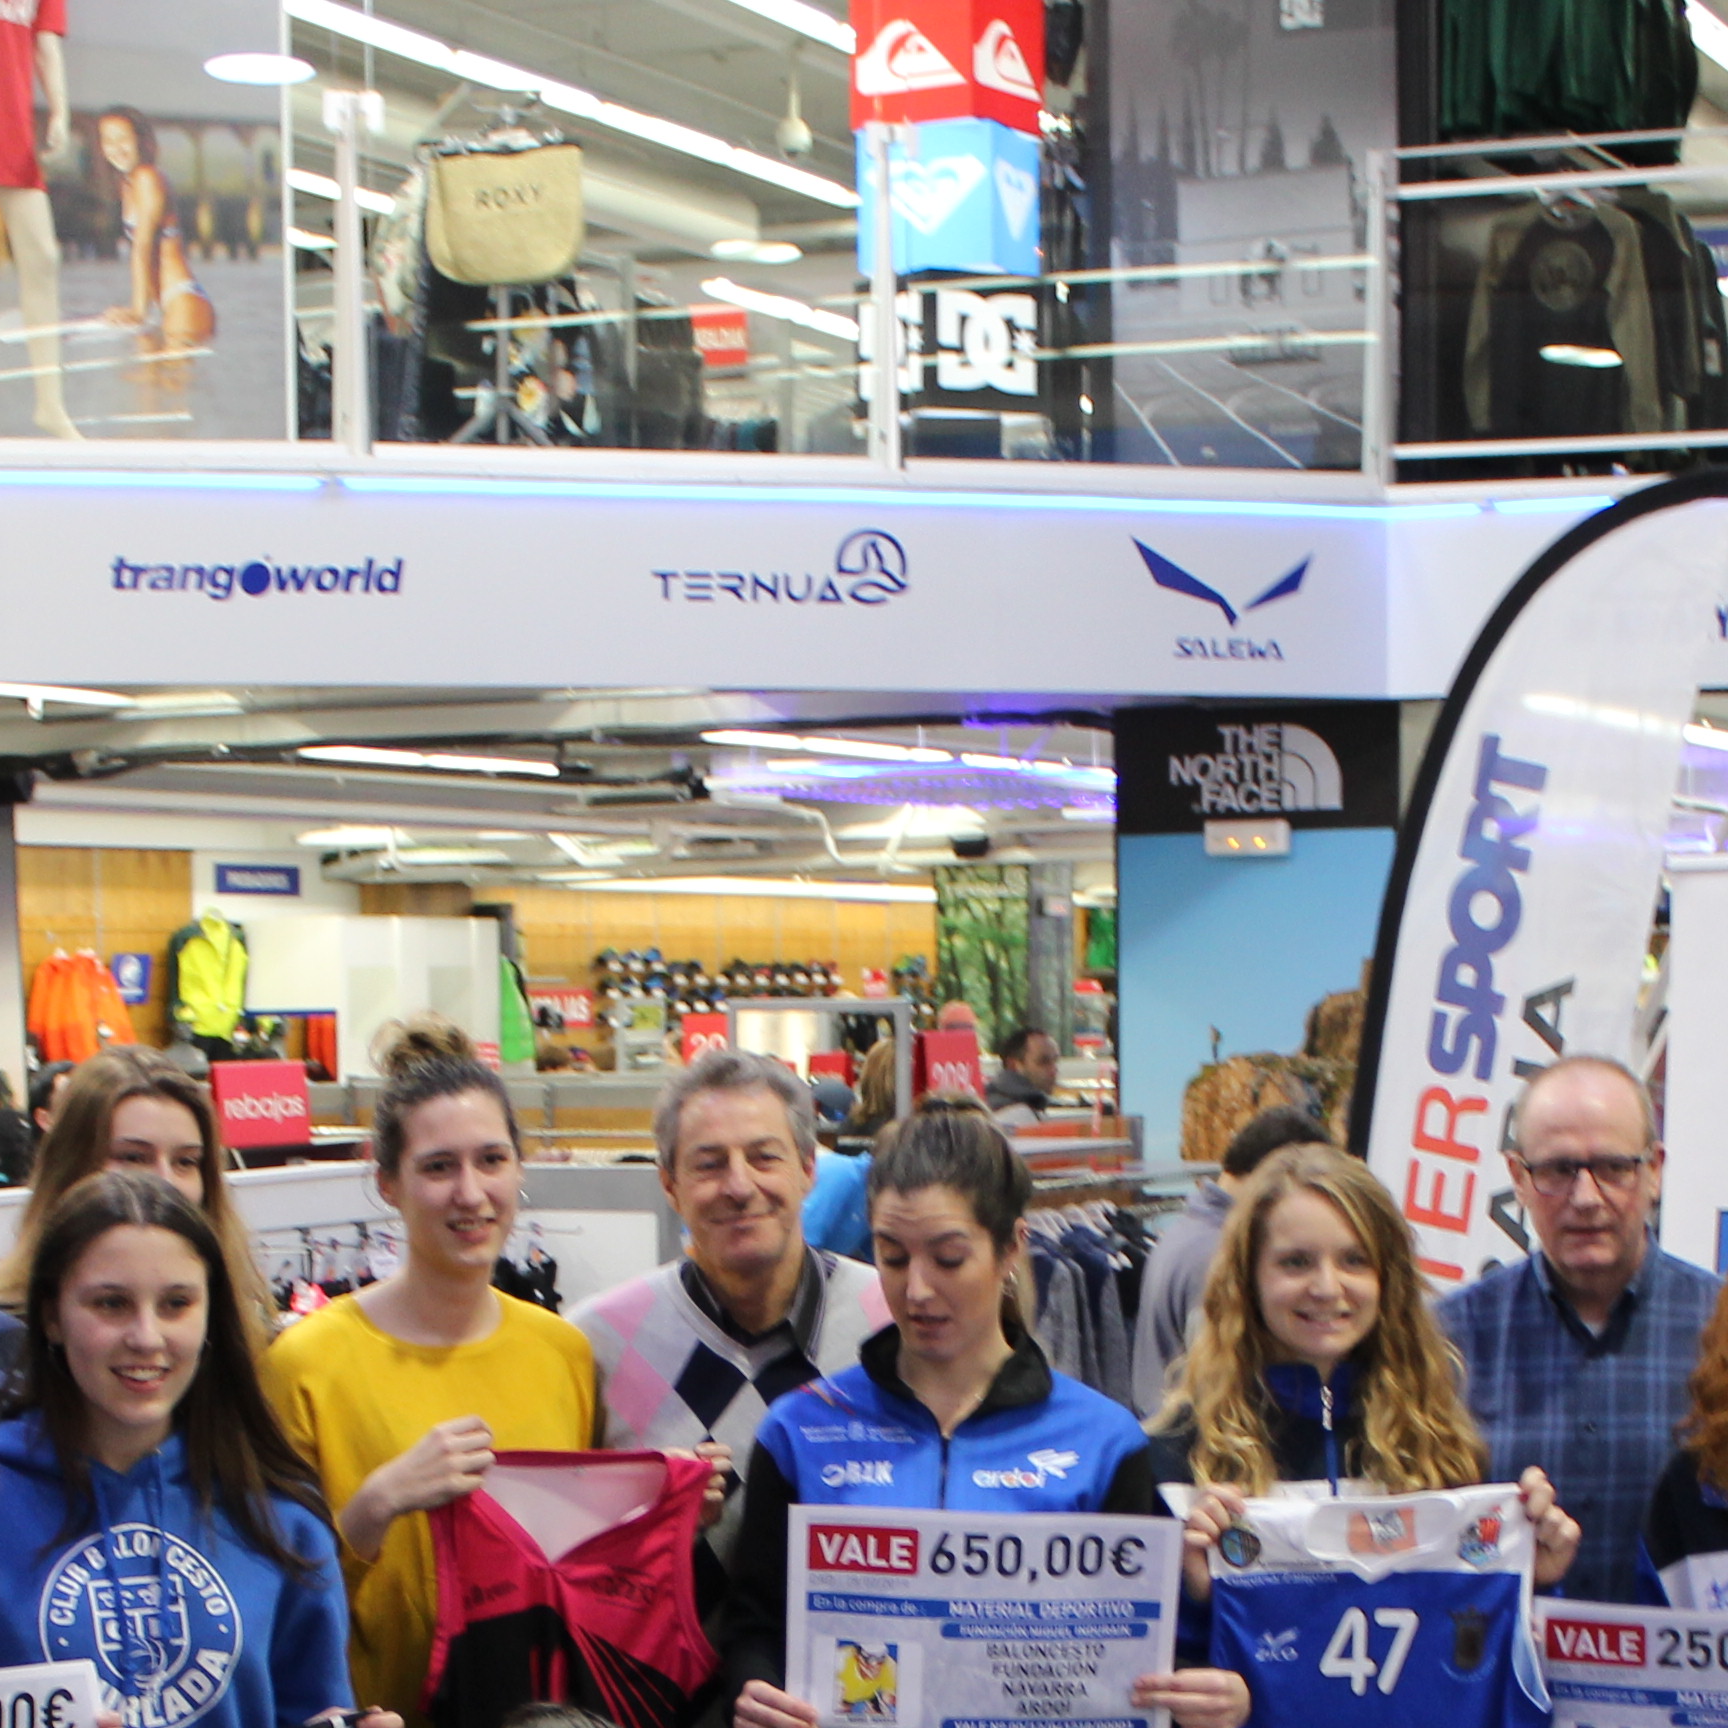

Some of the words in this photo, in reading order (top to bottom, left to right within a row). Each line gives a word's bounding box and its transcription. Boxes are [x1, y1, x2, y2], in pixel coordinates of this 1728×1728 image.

[475, 184, 545, 209] ROXY
[652, 571, 843, 603] TERNUA
[1173, 636, 1285, 661] SALEWA
[1218, 723, 1280, 754] THE
[1169, 753, 1280, 783] NORTH
[1200, 782, 1280, 812] FACE
[224, 1093, 306, 1123] rebajas
[817, 1532, 914, 1569] VALE
[929, 1531, 1147, 1584] 650,00€
[49, 1561, 91, 1627] CLUB
[949, 1600, 1035, 1619] MATERIAL
[1039, 1601, 1134, 1619] DEPORTIVO
[986, 1642, 1106, 1660] BALONCESTO
[1319, 1606, 1420, 1697] 47
[1554, 1626, 1642, 1663] VALE
[1001, 1681, 1088, 1697] NAVARRA
